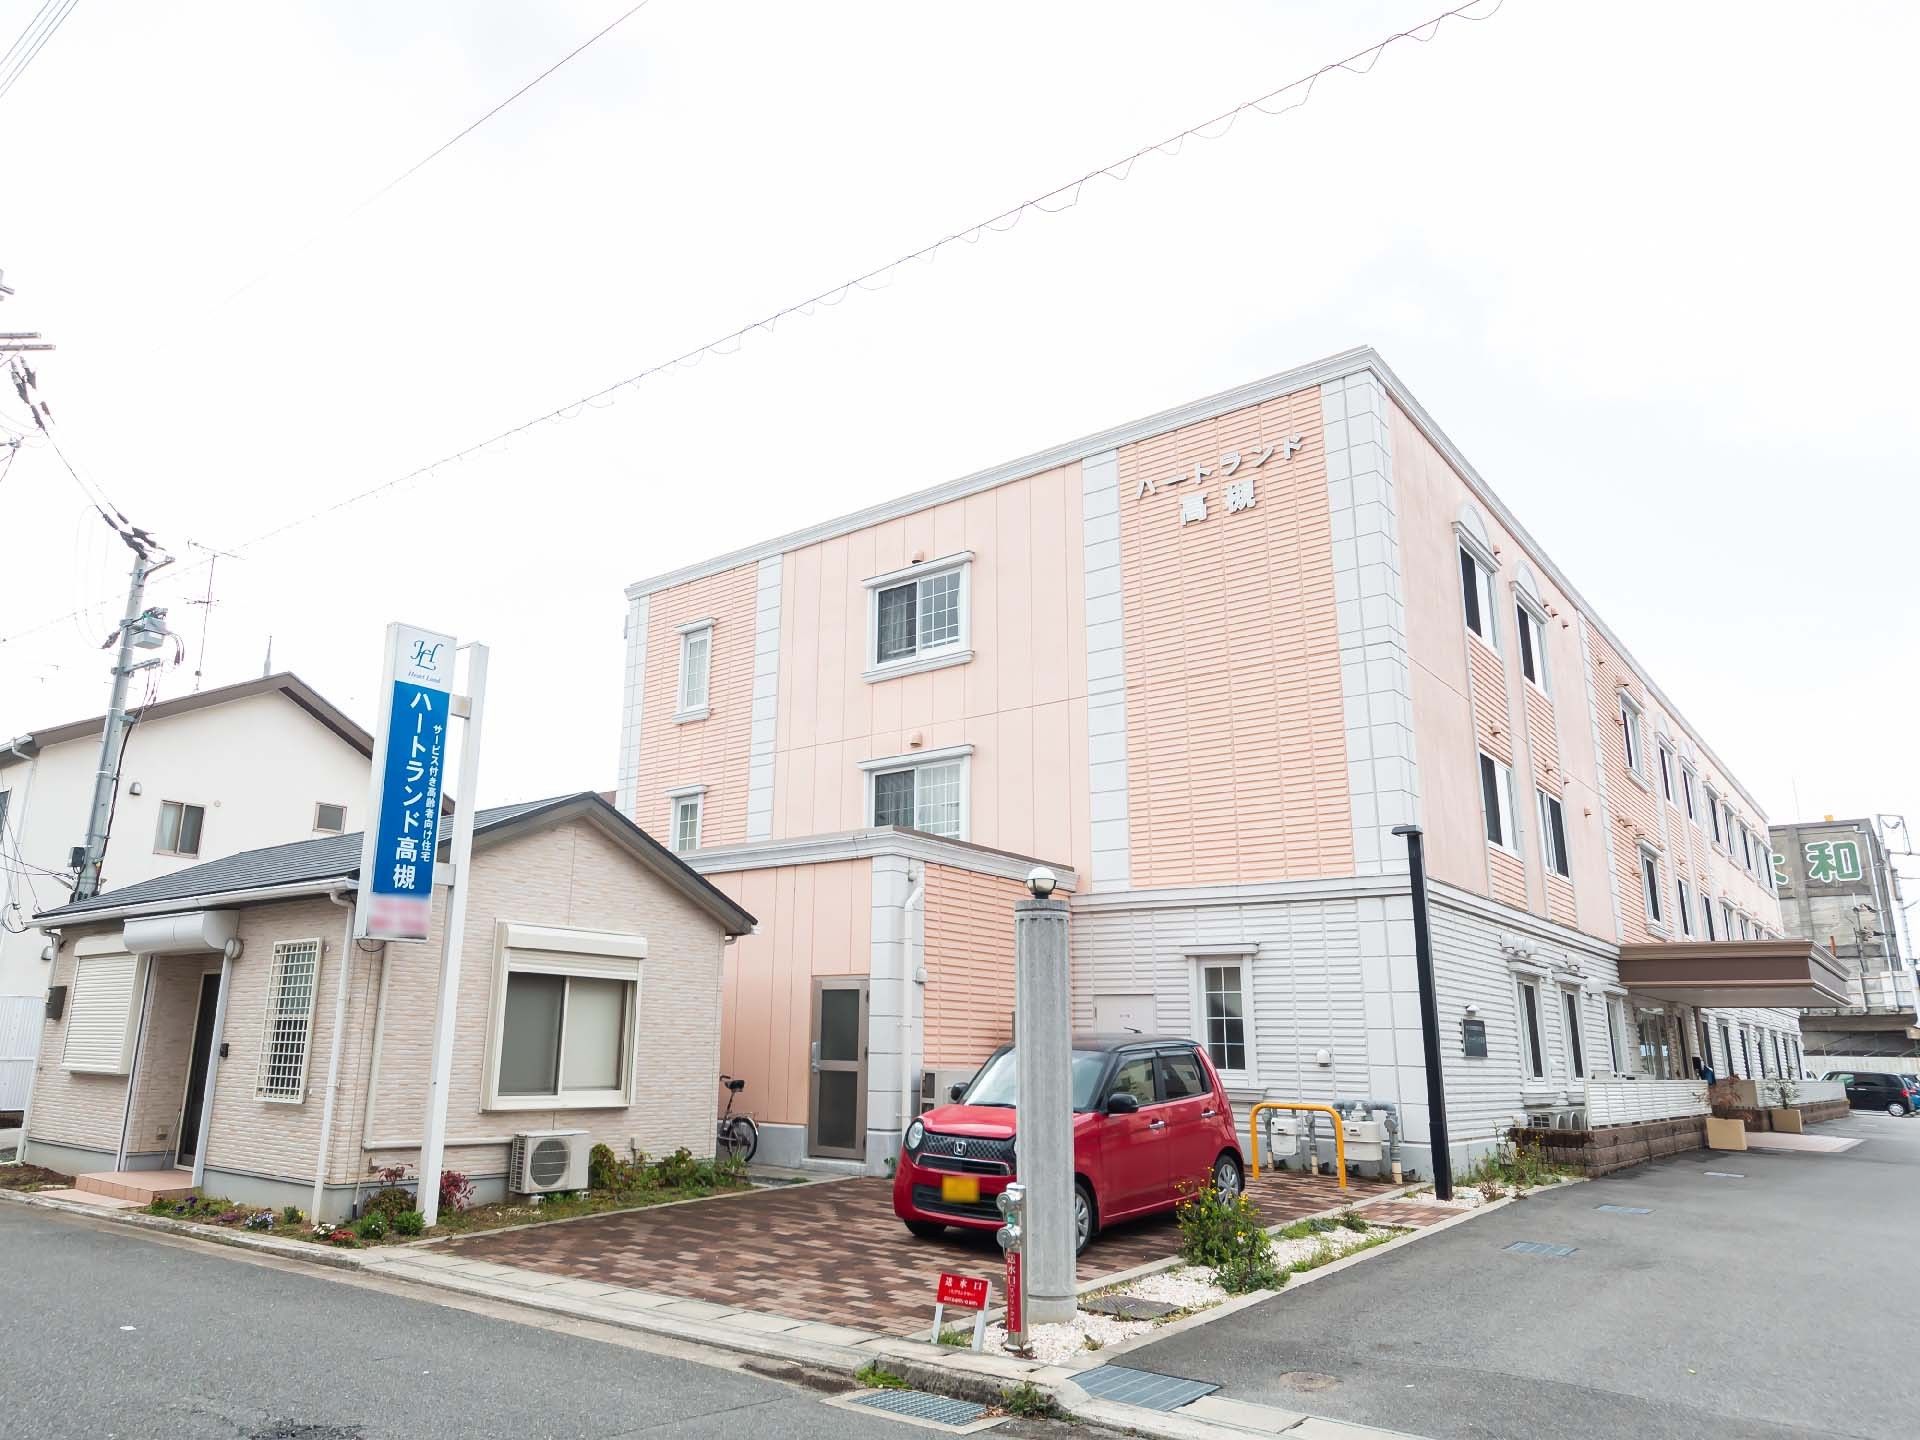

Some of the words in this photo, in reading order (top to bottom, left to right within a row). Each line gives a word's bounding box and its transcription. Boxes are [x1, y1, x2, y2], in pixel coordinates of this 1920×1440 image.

[1136, 432, 1303, 499] ハートランド
[1180, 480, 1256, 527] 高槻
[393, 692, 432, 890] ハートランド高槻
[420, 724, 442, 863] サービス付き高齢者向け住宅
